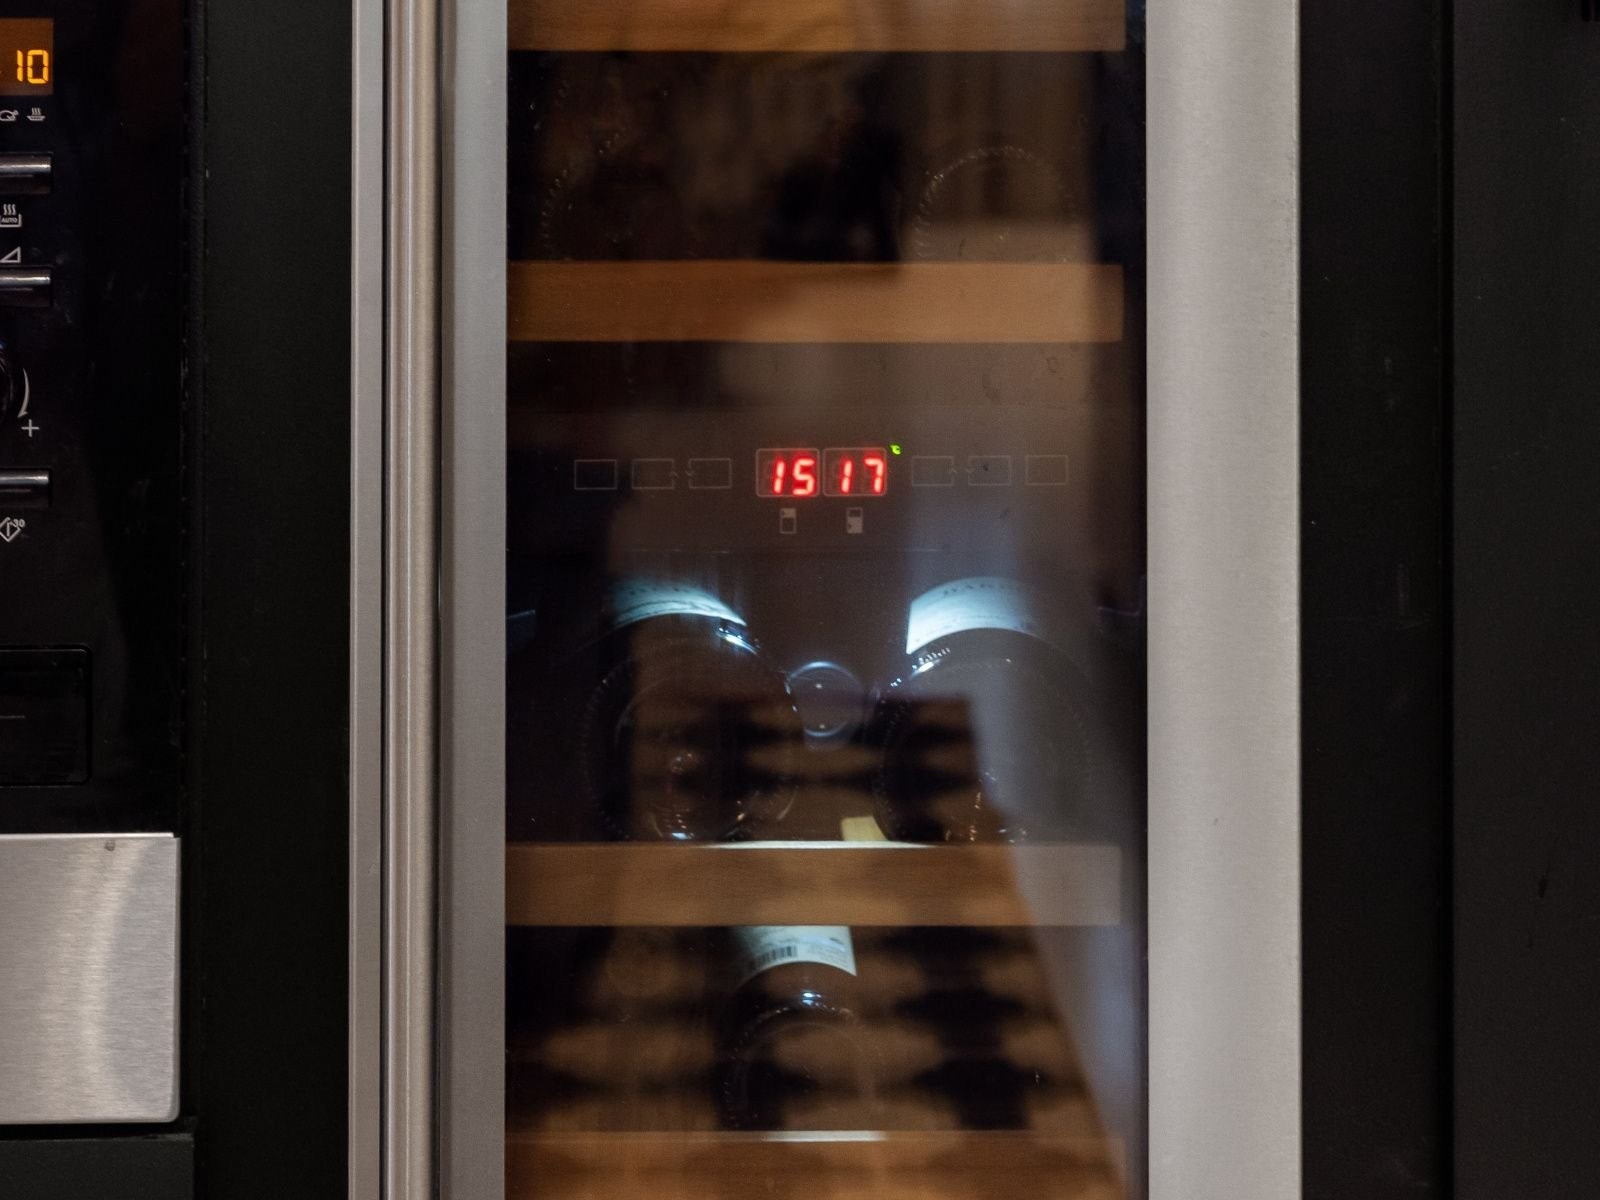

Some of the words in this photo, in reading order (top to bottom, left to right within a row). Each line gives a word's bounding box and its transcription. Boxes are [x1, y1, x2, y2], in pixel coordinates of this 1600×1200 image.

[16, 49, 49, 84] 10
[772, 458, 815, 495] 15
[840, 458, 884, 494] 17
